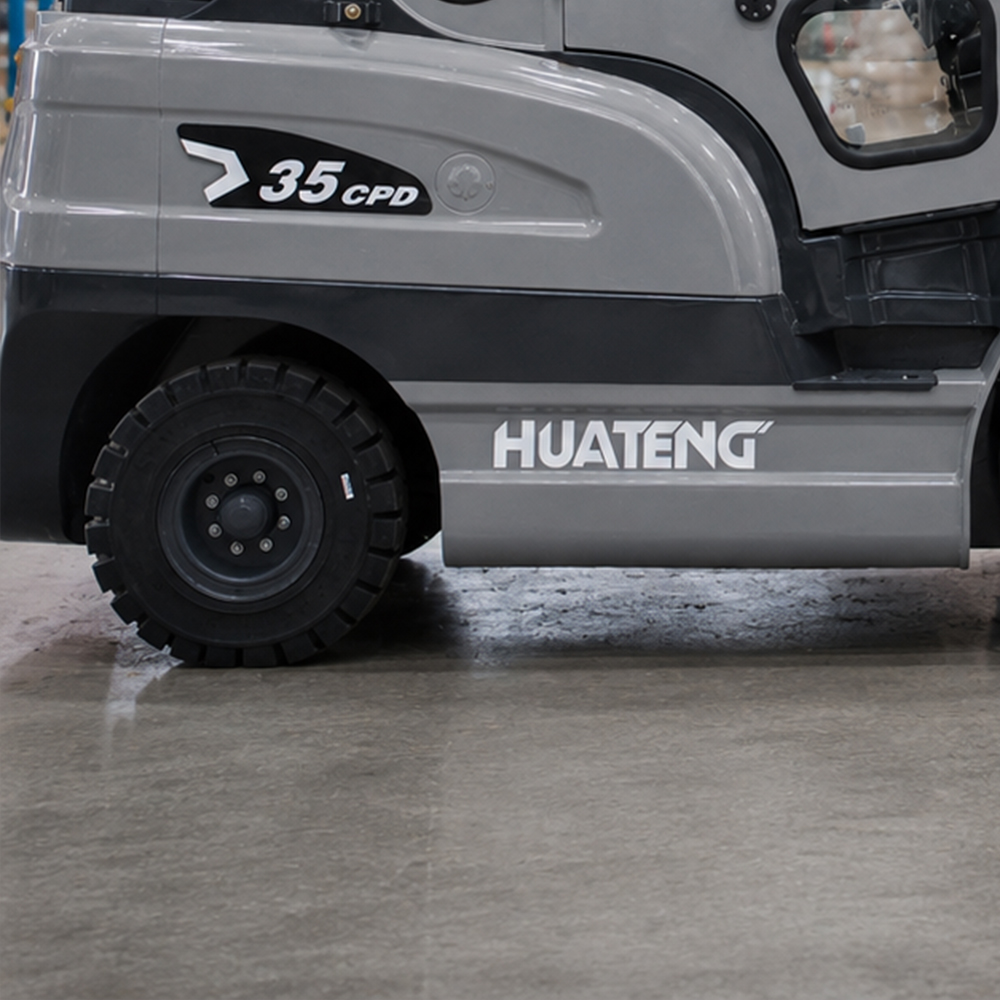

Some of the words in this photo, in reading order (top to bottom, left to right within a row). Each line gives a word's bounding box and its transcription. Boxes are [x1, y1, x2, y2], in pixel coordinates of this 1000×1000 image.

[258, 158, 346, 204] 35
[340, 184, 420, 207] CPD
[493, 419, 775, 469] HUATENG
